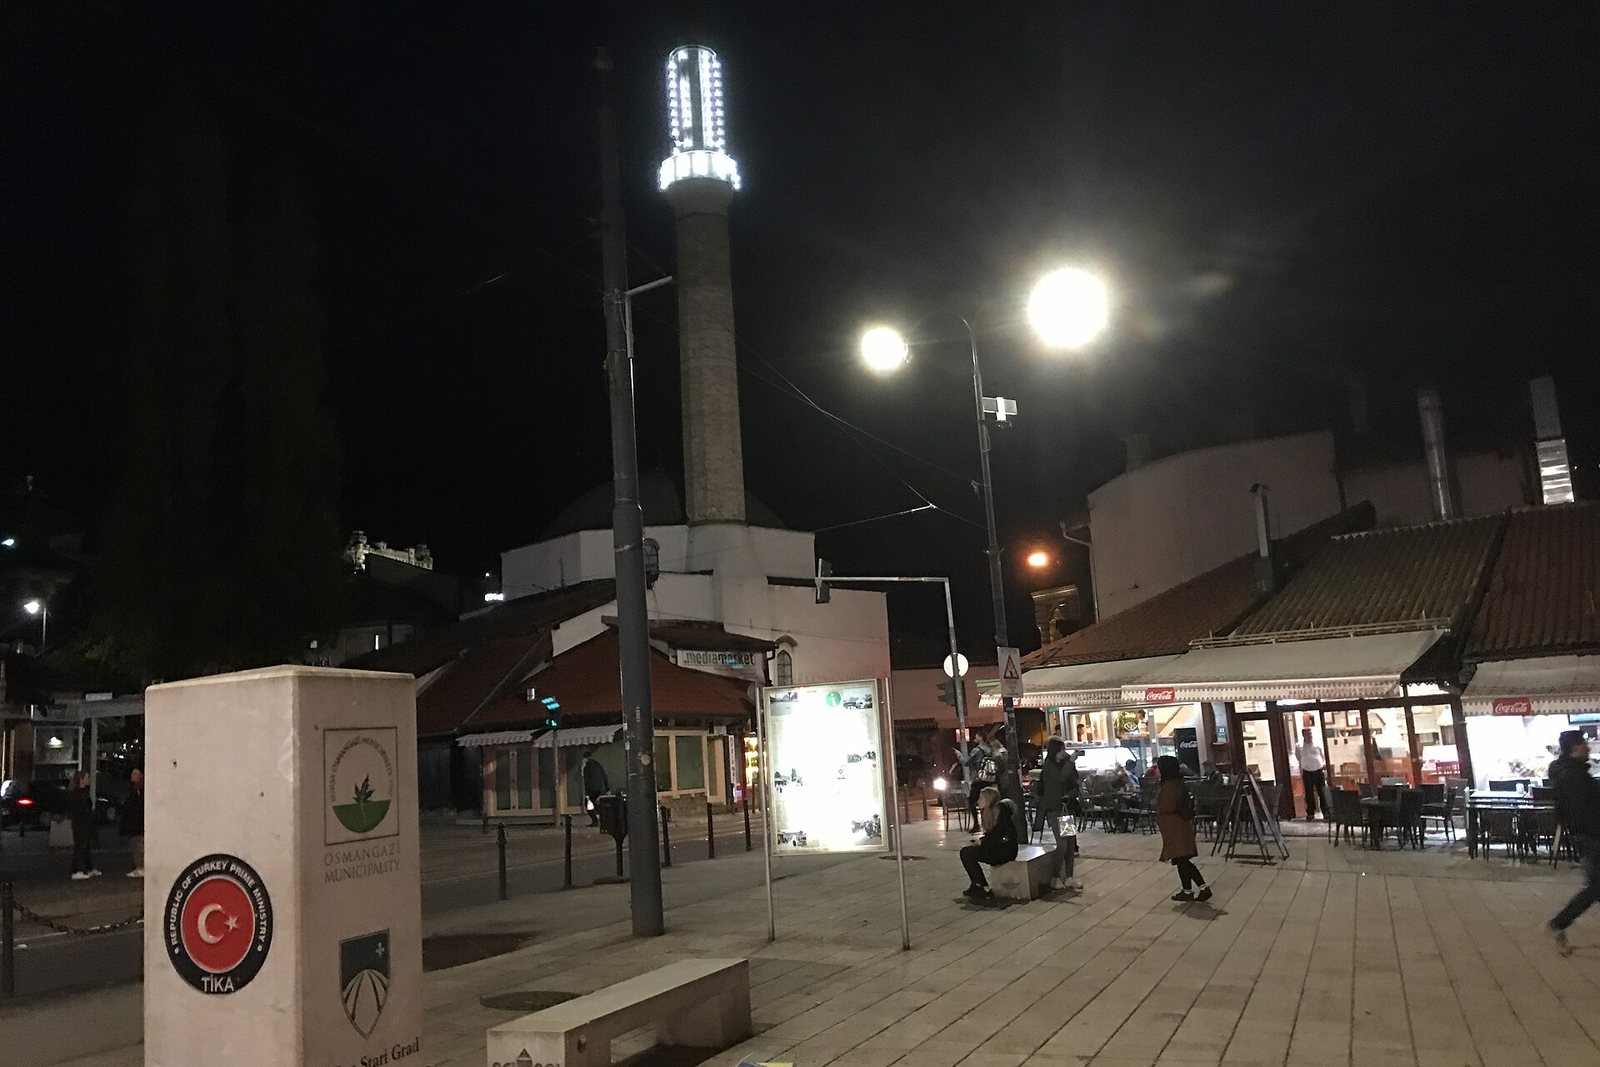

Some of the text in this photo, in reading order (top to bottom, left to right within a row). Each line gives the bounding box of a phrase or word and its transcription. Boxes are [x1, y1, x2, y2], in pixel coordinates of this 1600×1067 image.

[324, 858, 400, 883] MUNICIPALITY
[169, 860, 267, 946] REPUBLIC OF TURKEY PRIME MINISTRY
[391, 1036, 419, 1061] Grad
